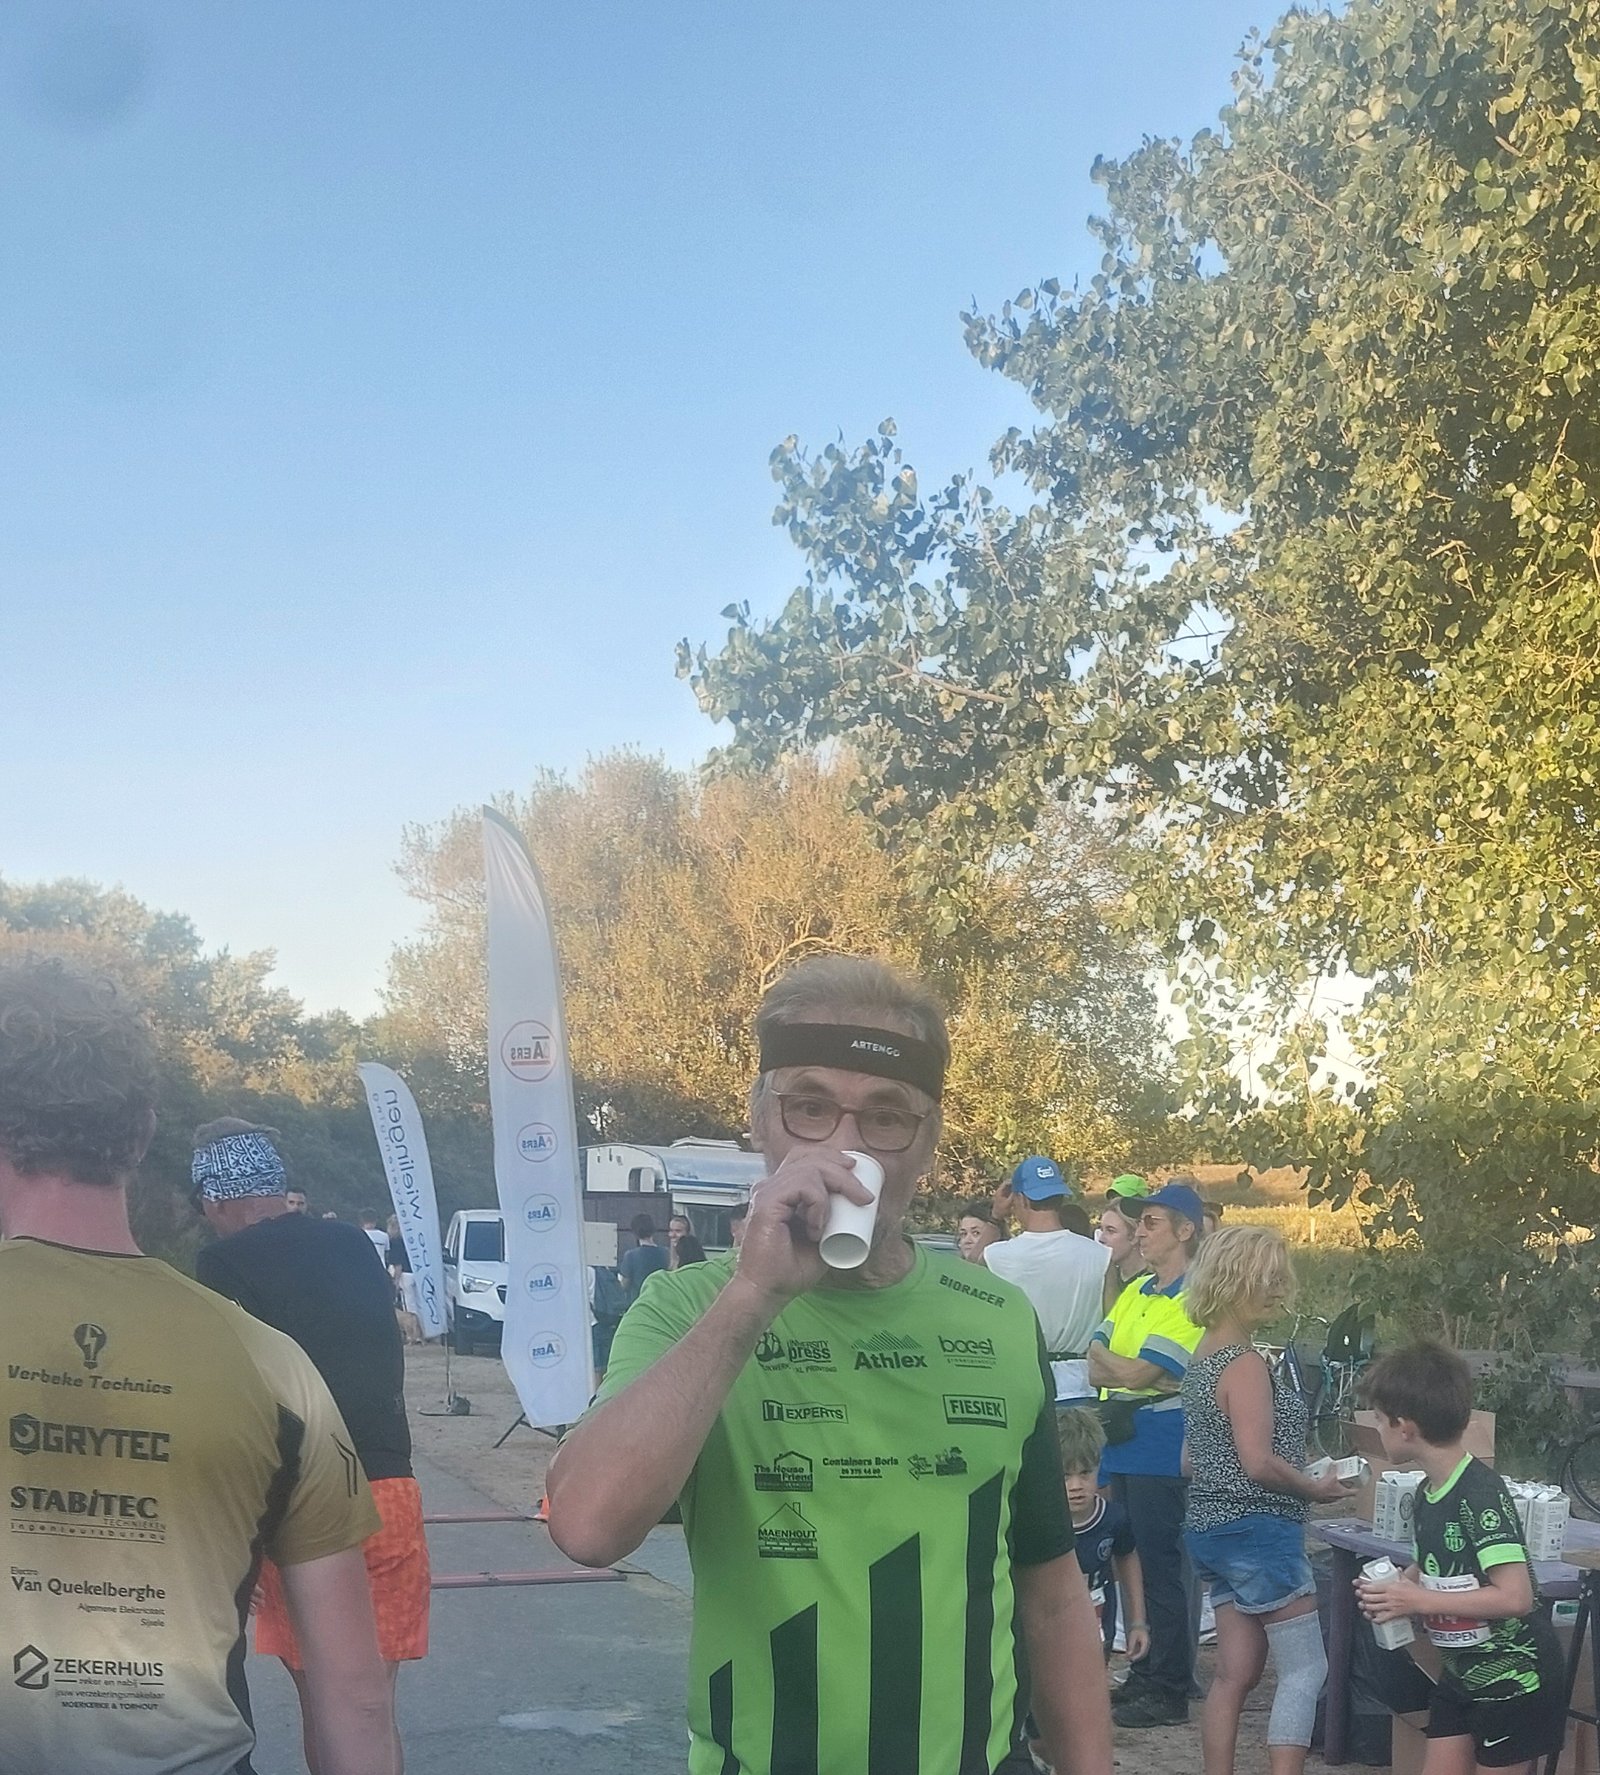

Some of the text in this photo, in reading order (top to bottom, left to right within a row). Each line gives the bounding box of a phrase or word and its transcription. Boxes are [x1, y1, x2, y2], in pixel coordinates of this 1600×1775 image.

[850, 1040, 900, 1057] ARTENGO
[939, 1274, 1006, 1308] BIORACER
[789, 1346, 831, 1362] press
[854, 1351, 928, 1371] Athlex
[7, 1365, 173, 1395] Verbeke Technics
[786, 1407, 844, 1420] EXPERTS
[950, 1400, 1003, 1418] FIESIEK
[42, 1422, 170, 1462] GRYTEC
[754, 1465, 771, 1473] The
[822, 1457, 872, 1466] Containers
[104, 1518, 167, 1531] TECHNIEKEN
[759, 1528, 816, 1538] MAENHOUT
[12, 1576, 165, 1602] Van Quekelberghe
[54, 1659, 163, 1677] ZEKERHUIS
